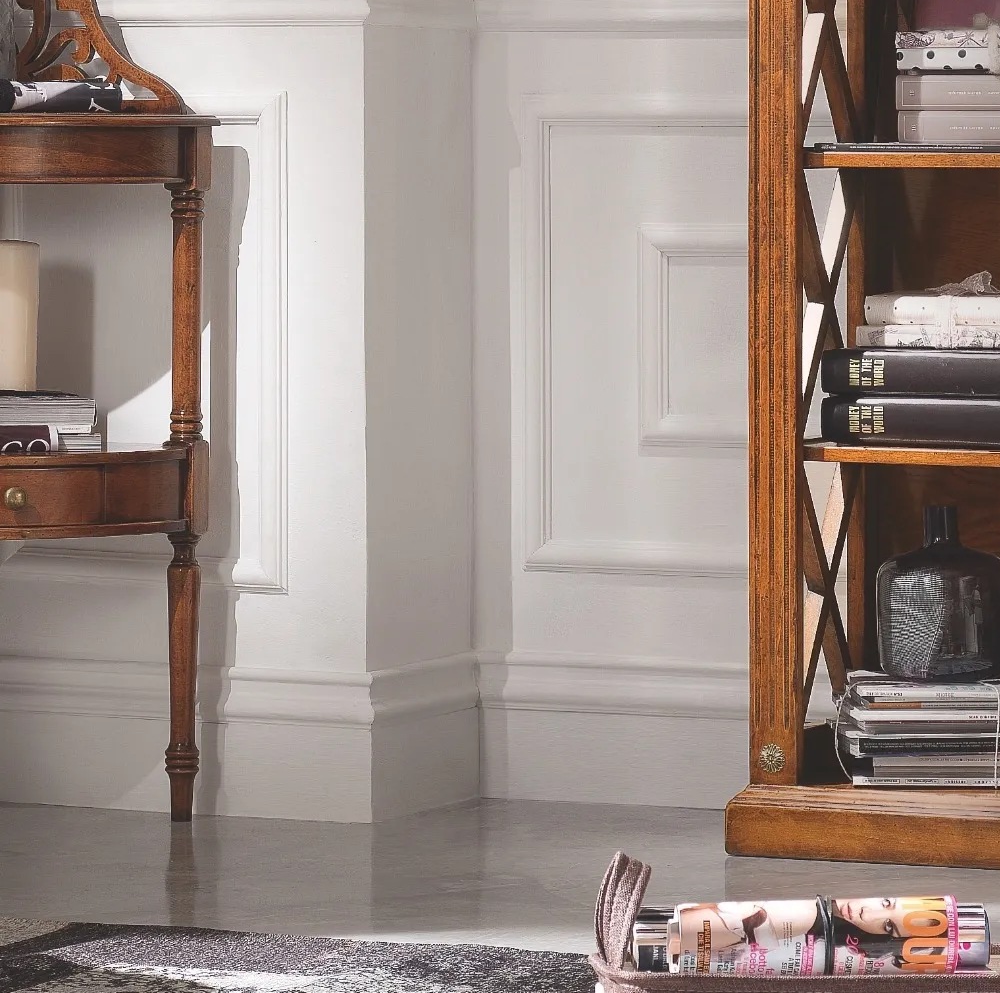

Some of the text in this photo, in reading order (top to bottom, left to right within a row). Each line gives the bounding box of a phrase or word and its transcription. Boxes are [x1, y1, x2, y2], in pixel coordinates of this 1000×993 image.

[849, 358, 860, 386] MONEY
[861, 358, 873, 386] OF THE
[873, 359, 884, 386] WORLD
[849, 405, 860, 433] MONEY
[861, 405, 872, 434] OF THE
[873, 406, 884, 433] WORLD
[703, 921, 711, 943] IMPARA
[946, 913, 955, 927] CON
[703, 950, 711, 964] SANO
[846, 935, 859, 954] 20
